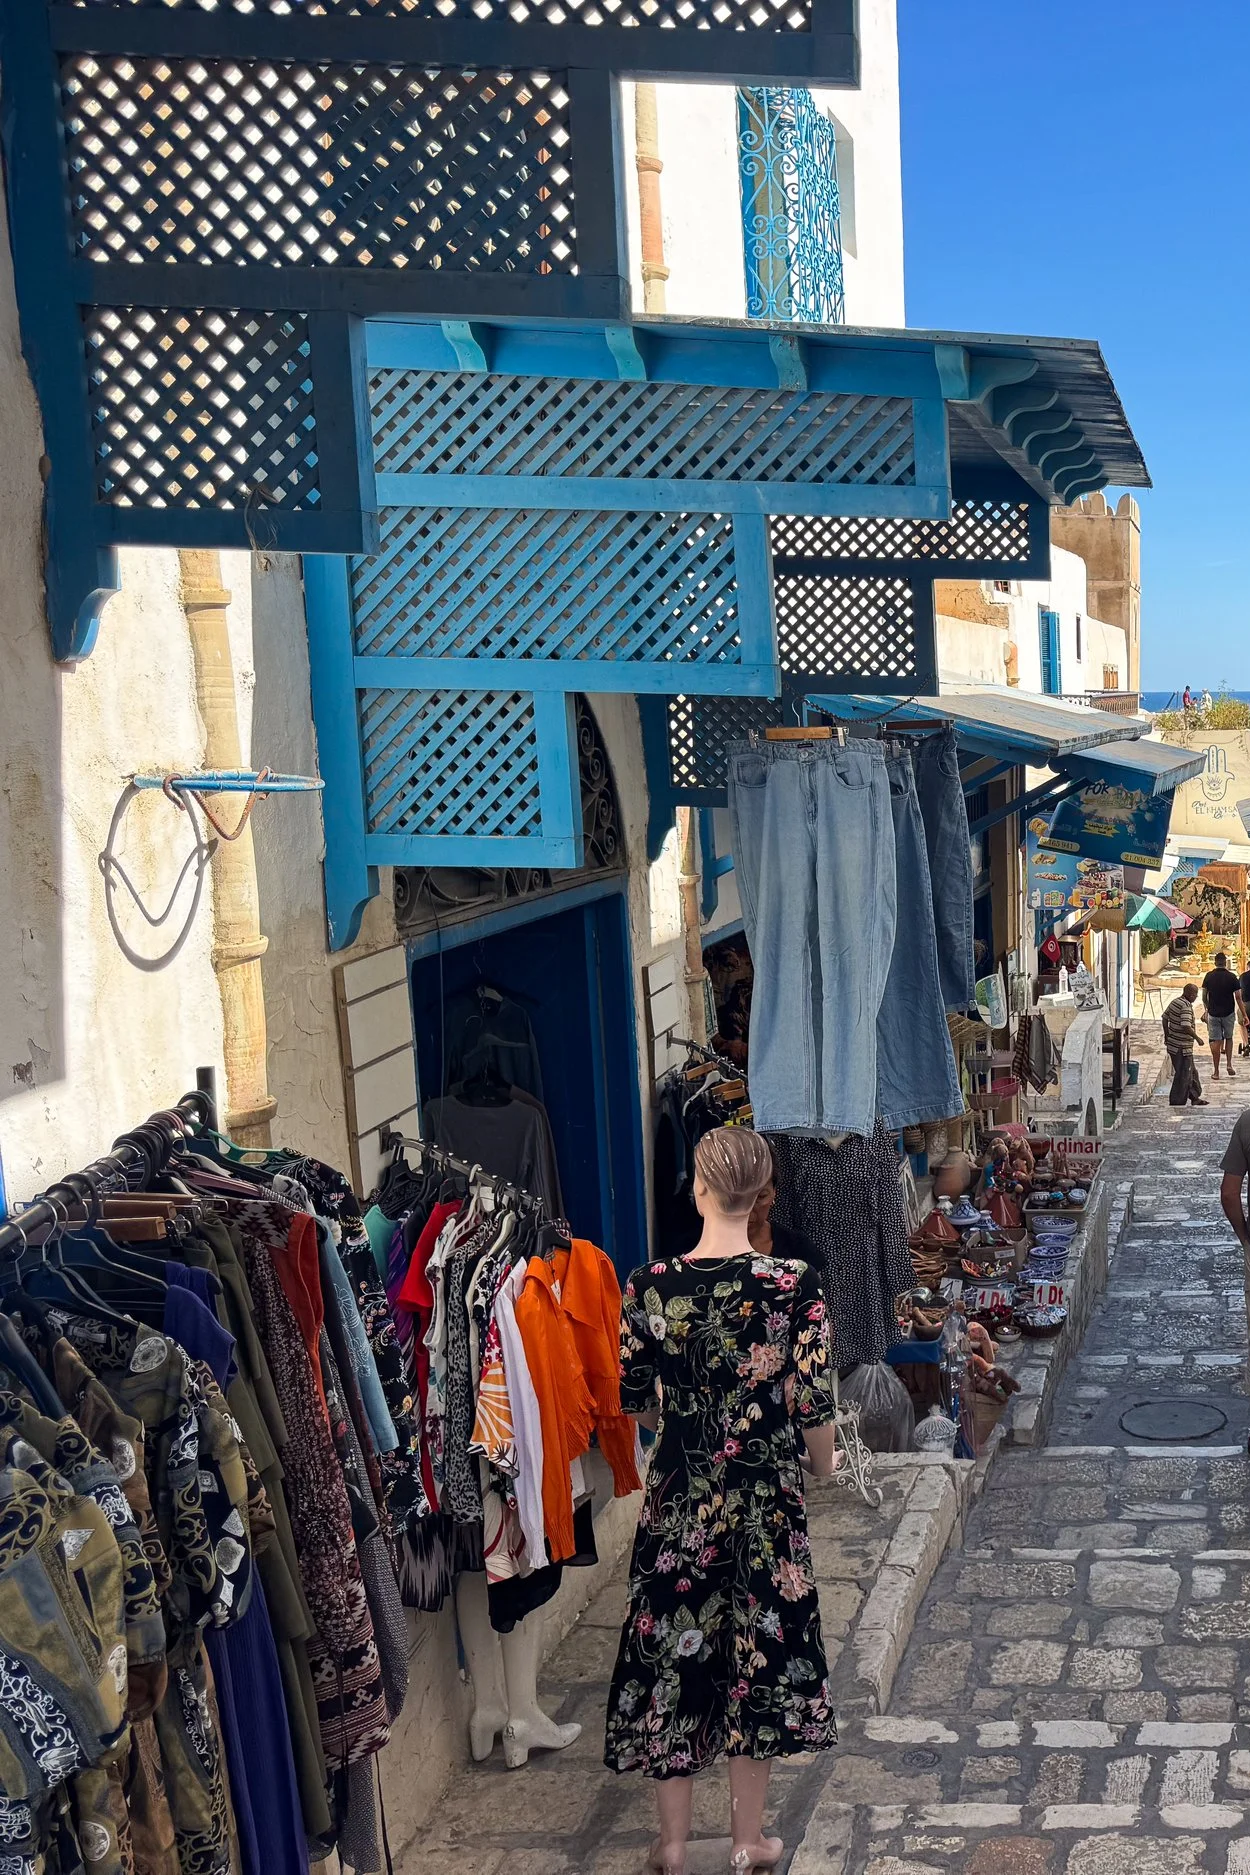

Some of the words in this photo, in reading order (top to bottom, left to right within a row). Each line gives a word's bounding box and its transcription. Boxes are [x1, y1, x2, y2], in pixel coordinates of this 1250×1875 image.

[1056, 1137, 1102, 1154] dinar
[979, 1290, 986, 1303] 1
[1036, 1285, 1043, 1304] 1
[1047, 1285, 1064, 1305] Dt
